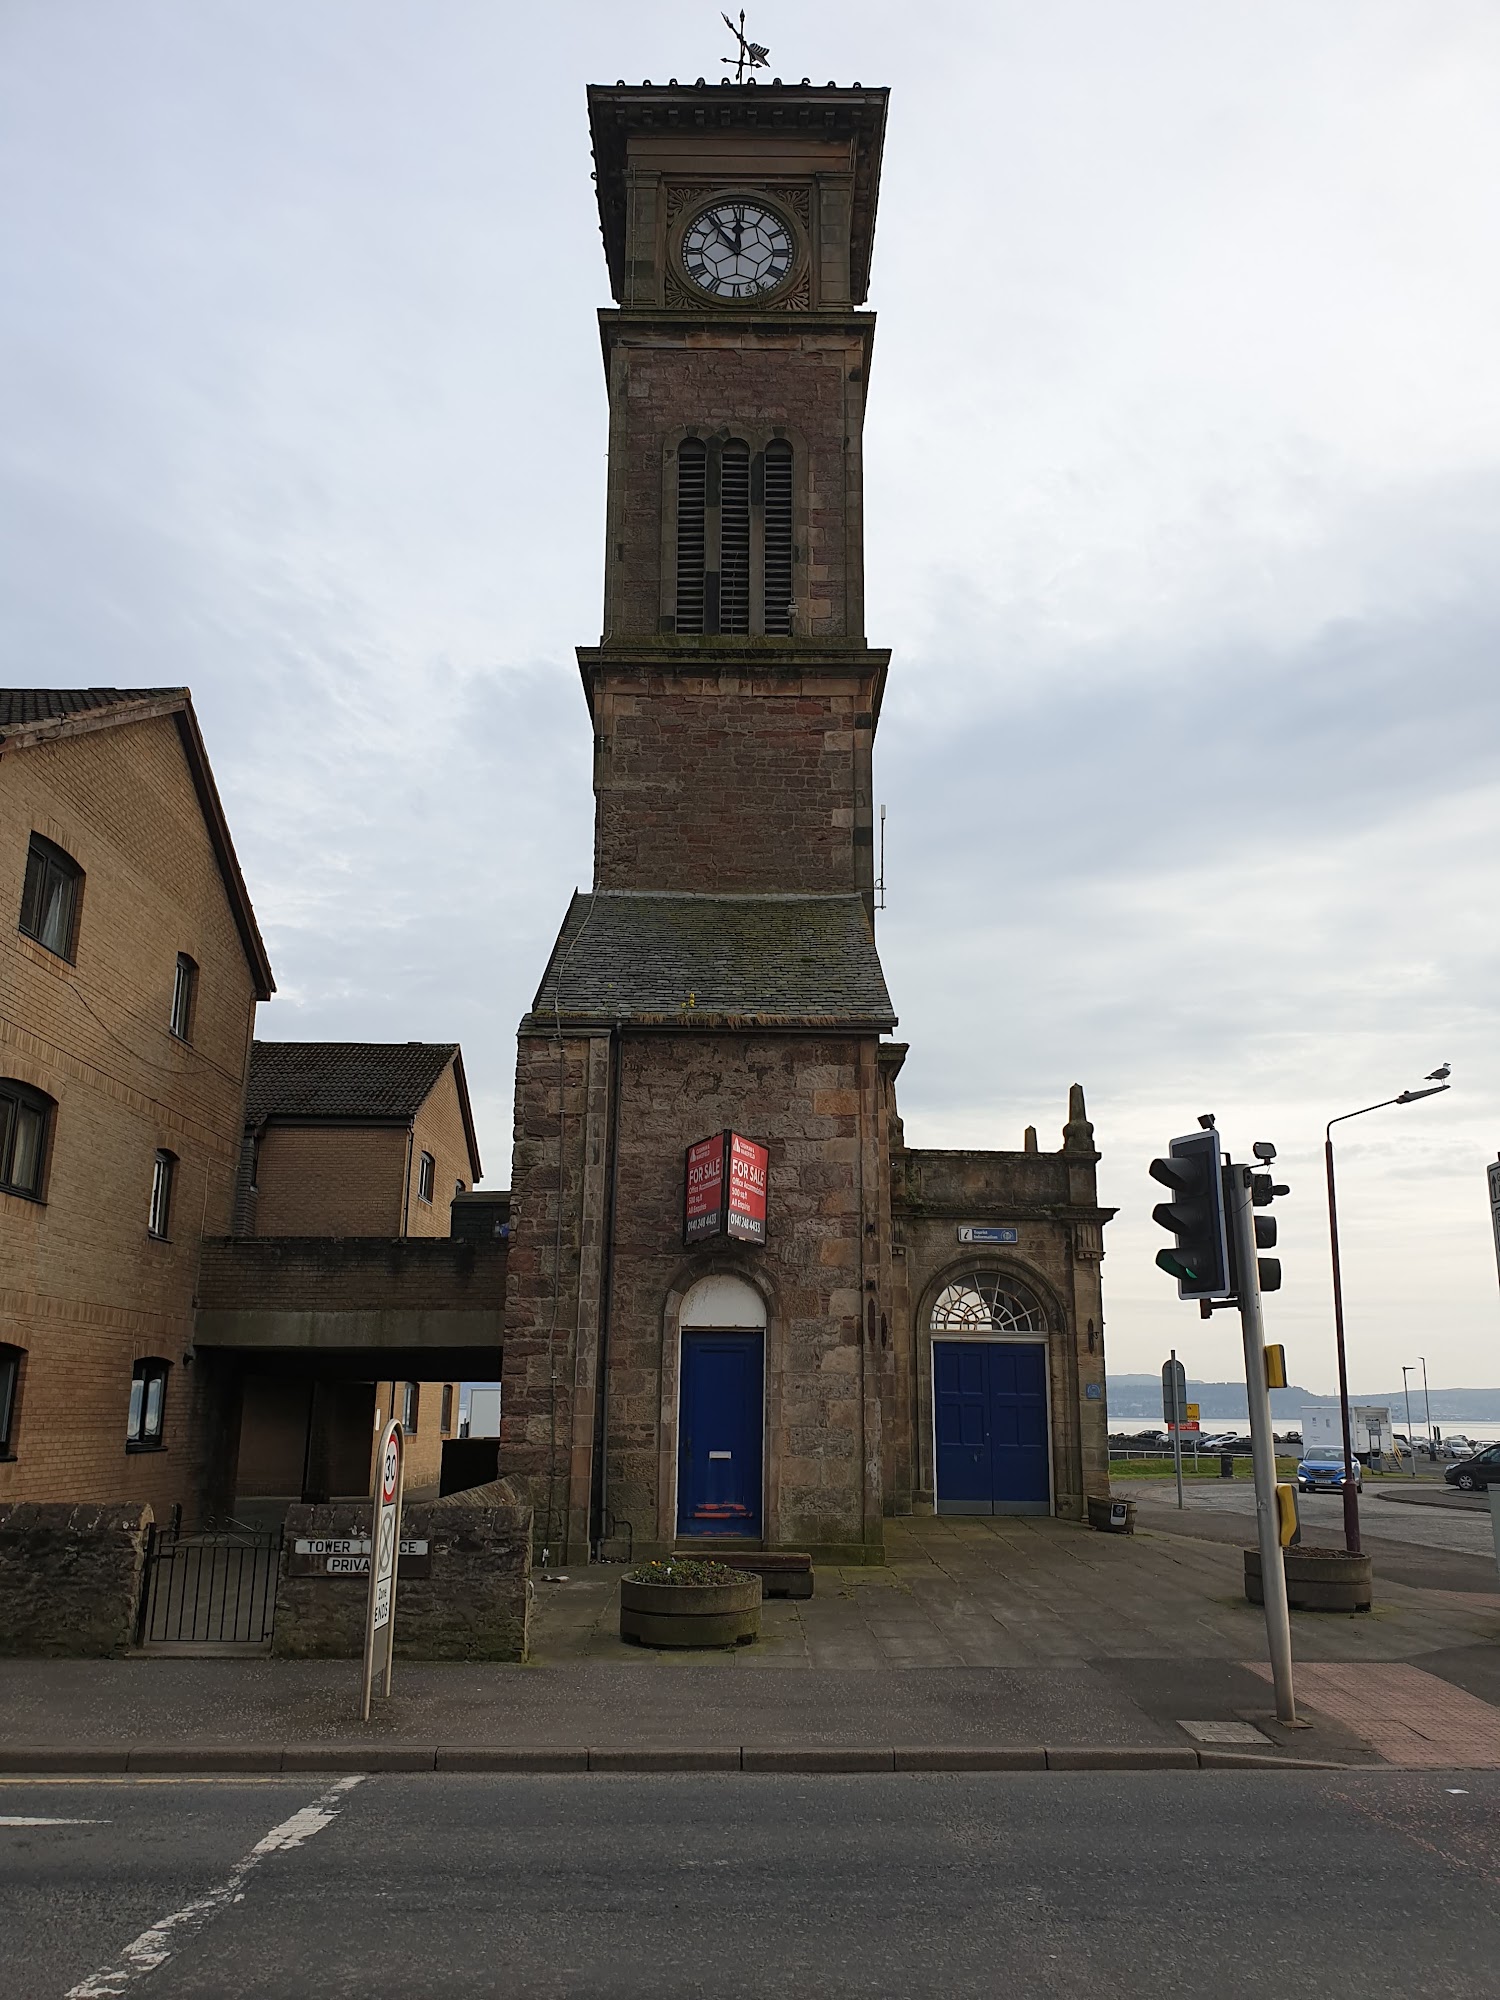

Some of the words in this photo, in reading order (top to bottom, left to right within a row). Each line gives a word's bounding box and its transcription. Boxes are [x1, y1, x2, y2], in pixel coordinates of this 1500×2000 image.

[689, 1167, 704, 1186] FOR
[704, 1159, 720, 1180] SALE
[732, 1159, 748, 1179] FOR
[749, 1166, 764, 1187] SALE
[732, 1176, 744, 1188] Office
[385, 1454, 396, 1482] 30
[307, 1540, 351, 1553] TOWER
[332, 1559, 370, 1571] PRIVA
[378, 1588, 387, 1600] Zone
[374, 1602, 388, 1622] ENDS
